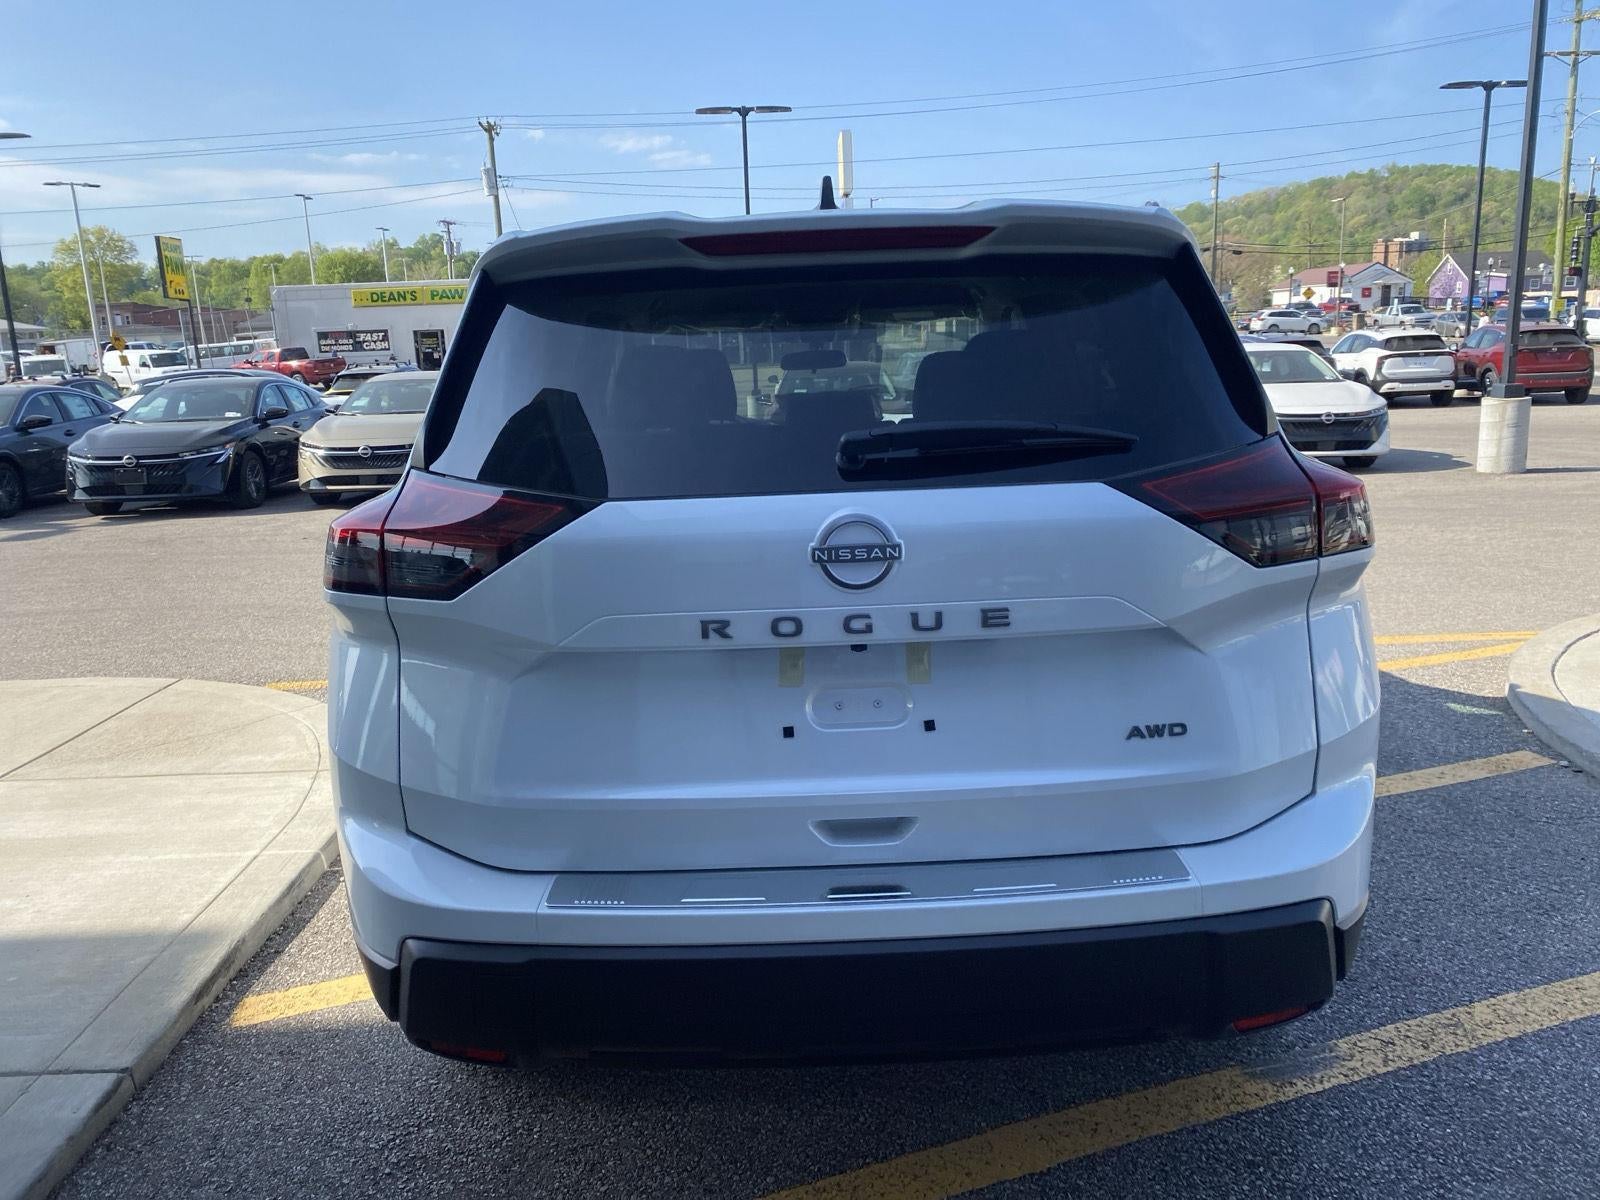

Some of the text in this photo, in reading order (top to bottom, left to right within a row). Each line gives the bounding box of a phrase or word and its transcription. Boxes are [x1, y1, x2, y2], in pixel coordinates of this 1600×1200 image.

[430, 288, 467, 300] PAW
[356, 332, 385, 341] FAST
[363, 341, 389, 350] CASH
[814, 547, 900, 561] NISSAN
[699, 607, 1011, 640] ROGUE
[1125, 722, 1188, 741] AWD
